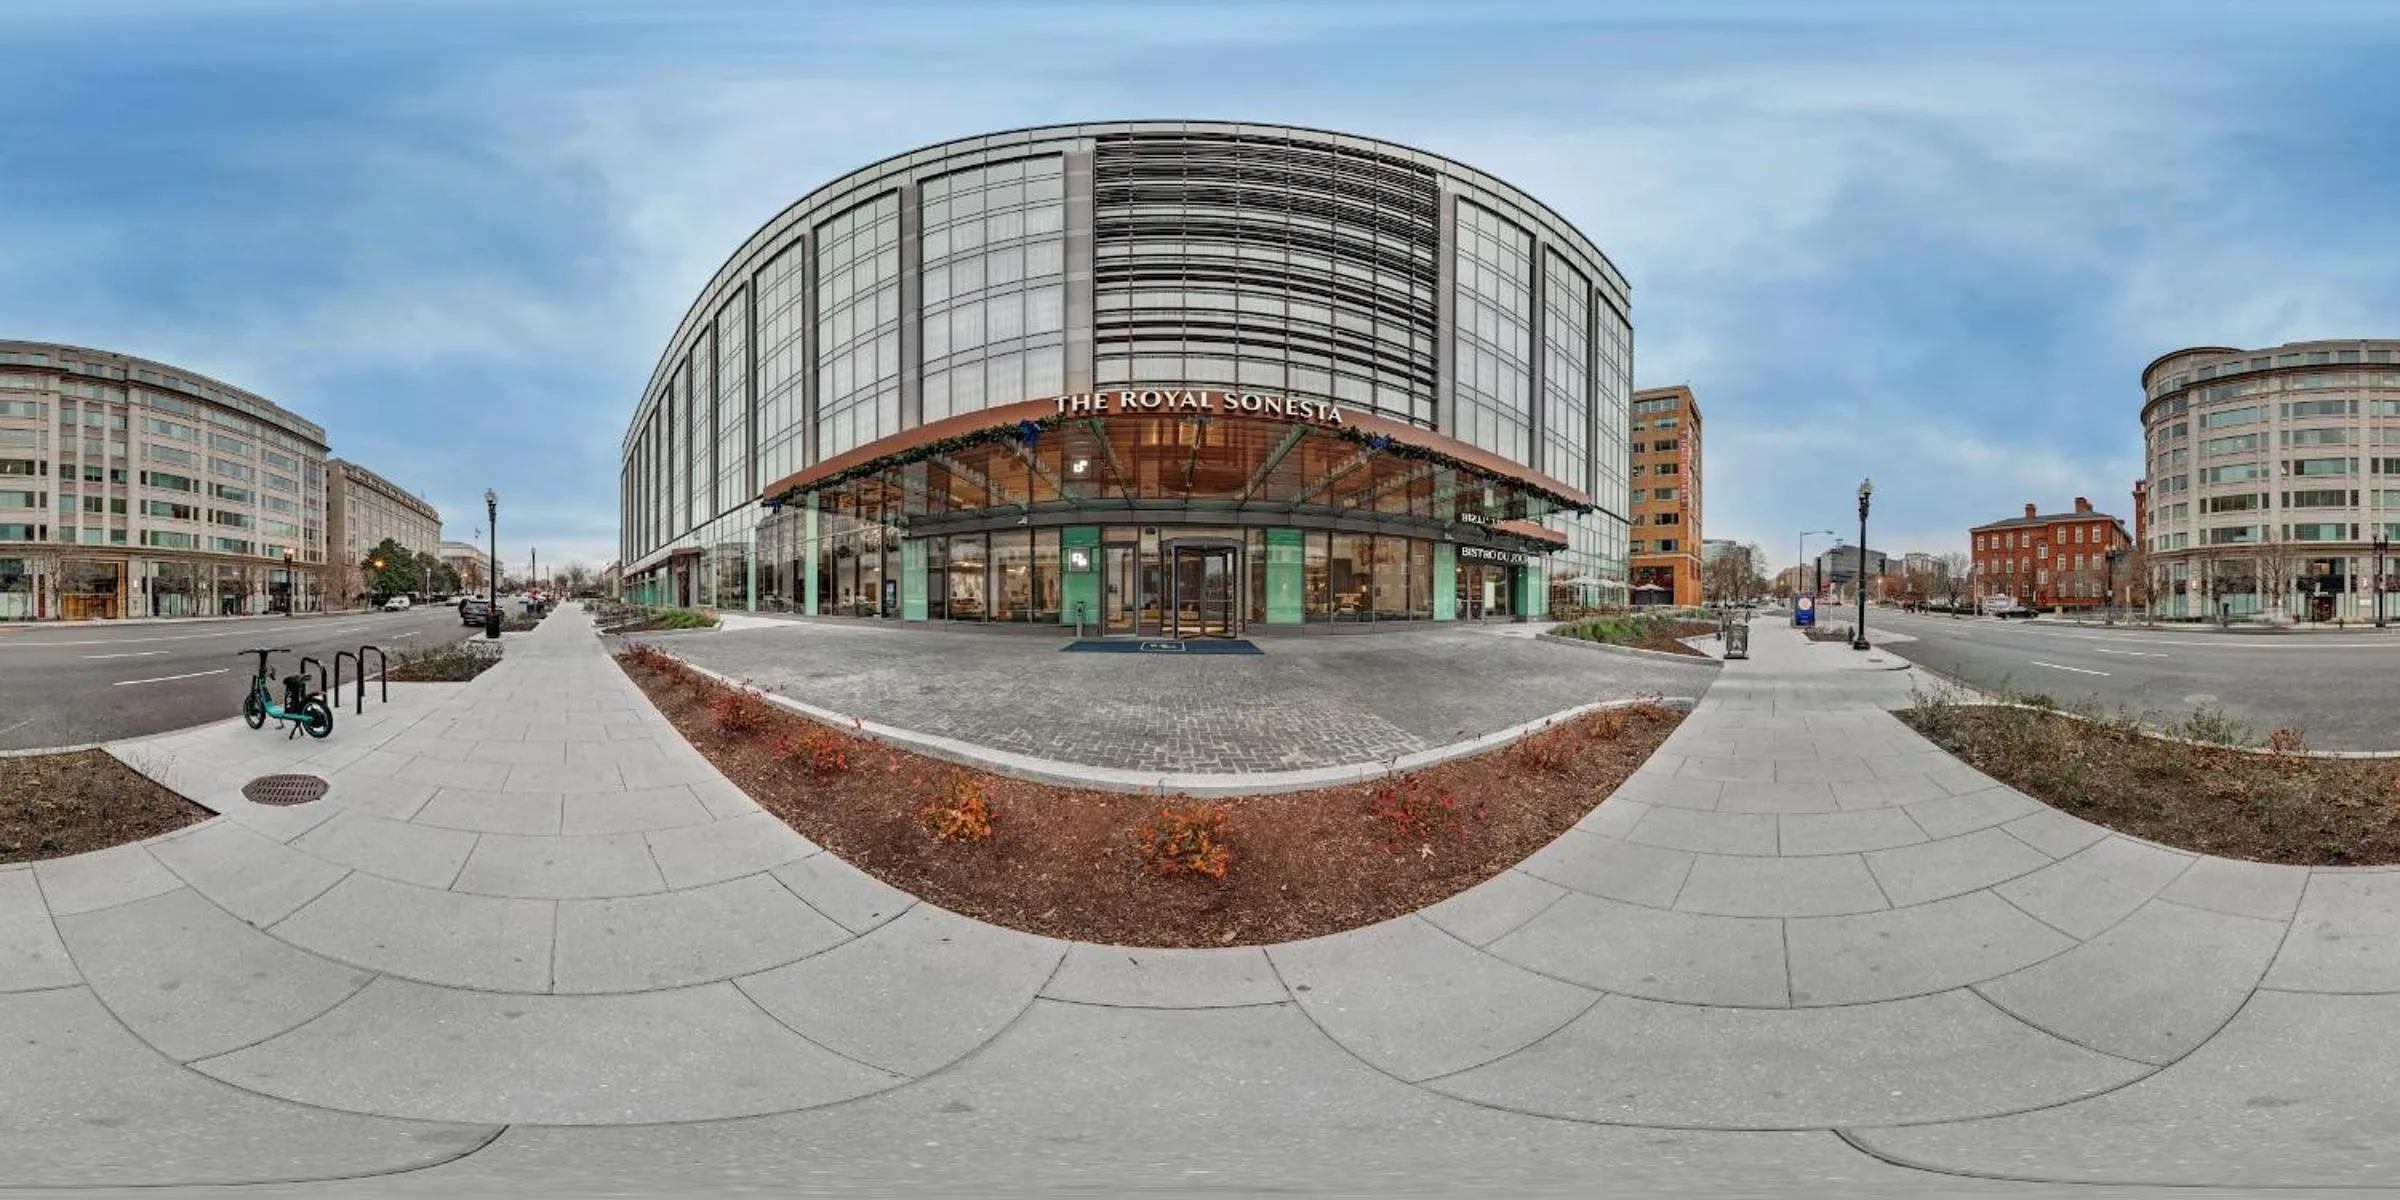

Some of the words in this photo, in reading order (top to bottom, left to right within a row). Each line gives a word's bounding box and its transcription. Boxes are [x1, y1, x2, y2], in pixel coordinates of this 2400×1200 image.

[1053, 393, 1109, 413] THE
[1120, 390, 1214, 409] ROYAL
[1223, 392, 1344, 423] SONESTA
[1461, 547, 1496, 559] BISTRO
[1497, 551, 1509, 561] DU
